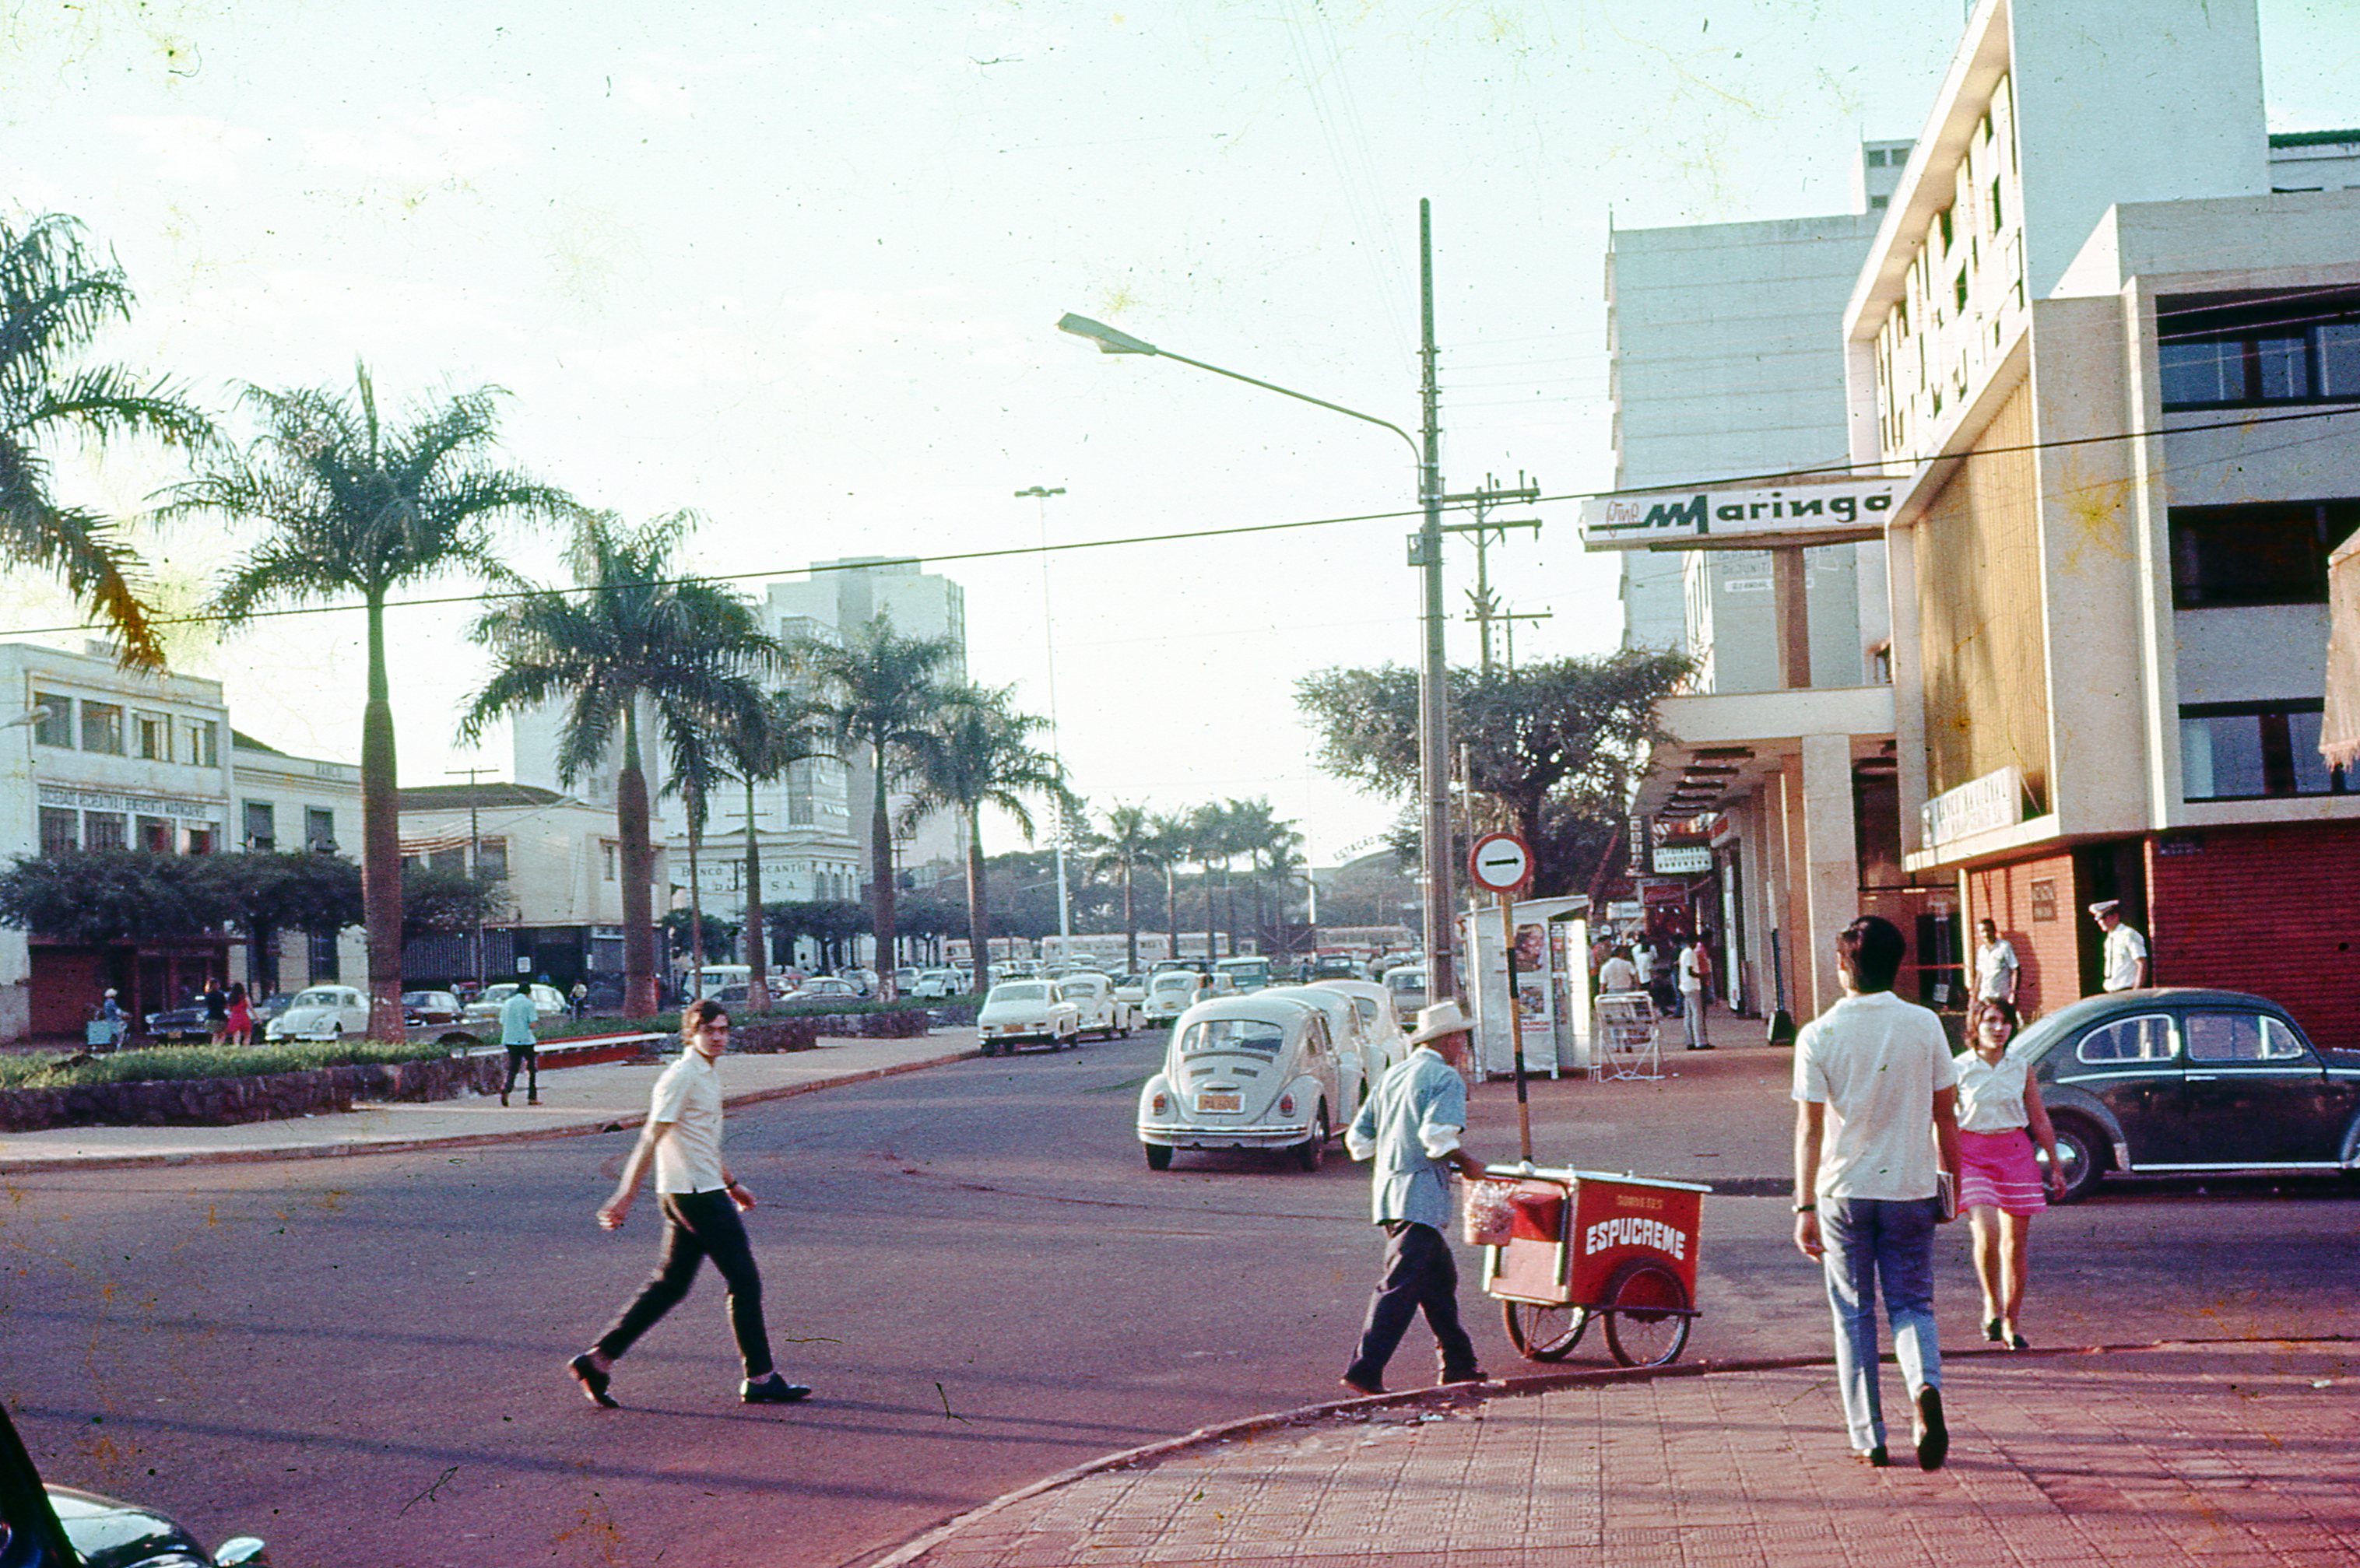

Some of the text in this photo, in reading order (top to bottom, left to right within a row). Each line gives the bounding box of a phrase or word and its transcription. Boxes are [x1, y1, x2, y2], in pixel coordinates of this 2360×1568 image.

[1642, 486, 1892, 535] Maringá
[1333, 835, 1375, 861] ESTAÇÃO
[682, 865, 722, 877] BNCO
[1586, 1217, 1686, 1261] ESPUCREME
